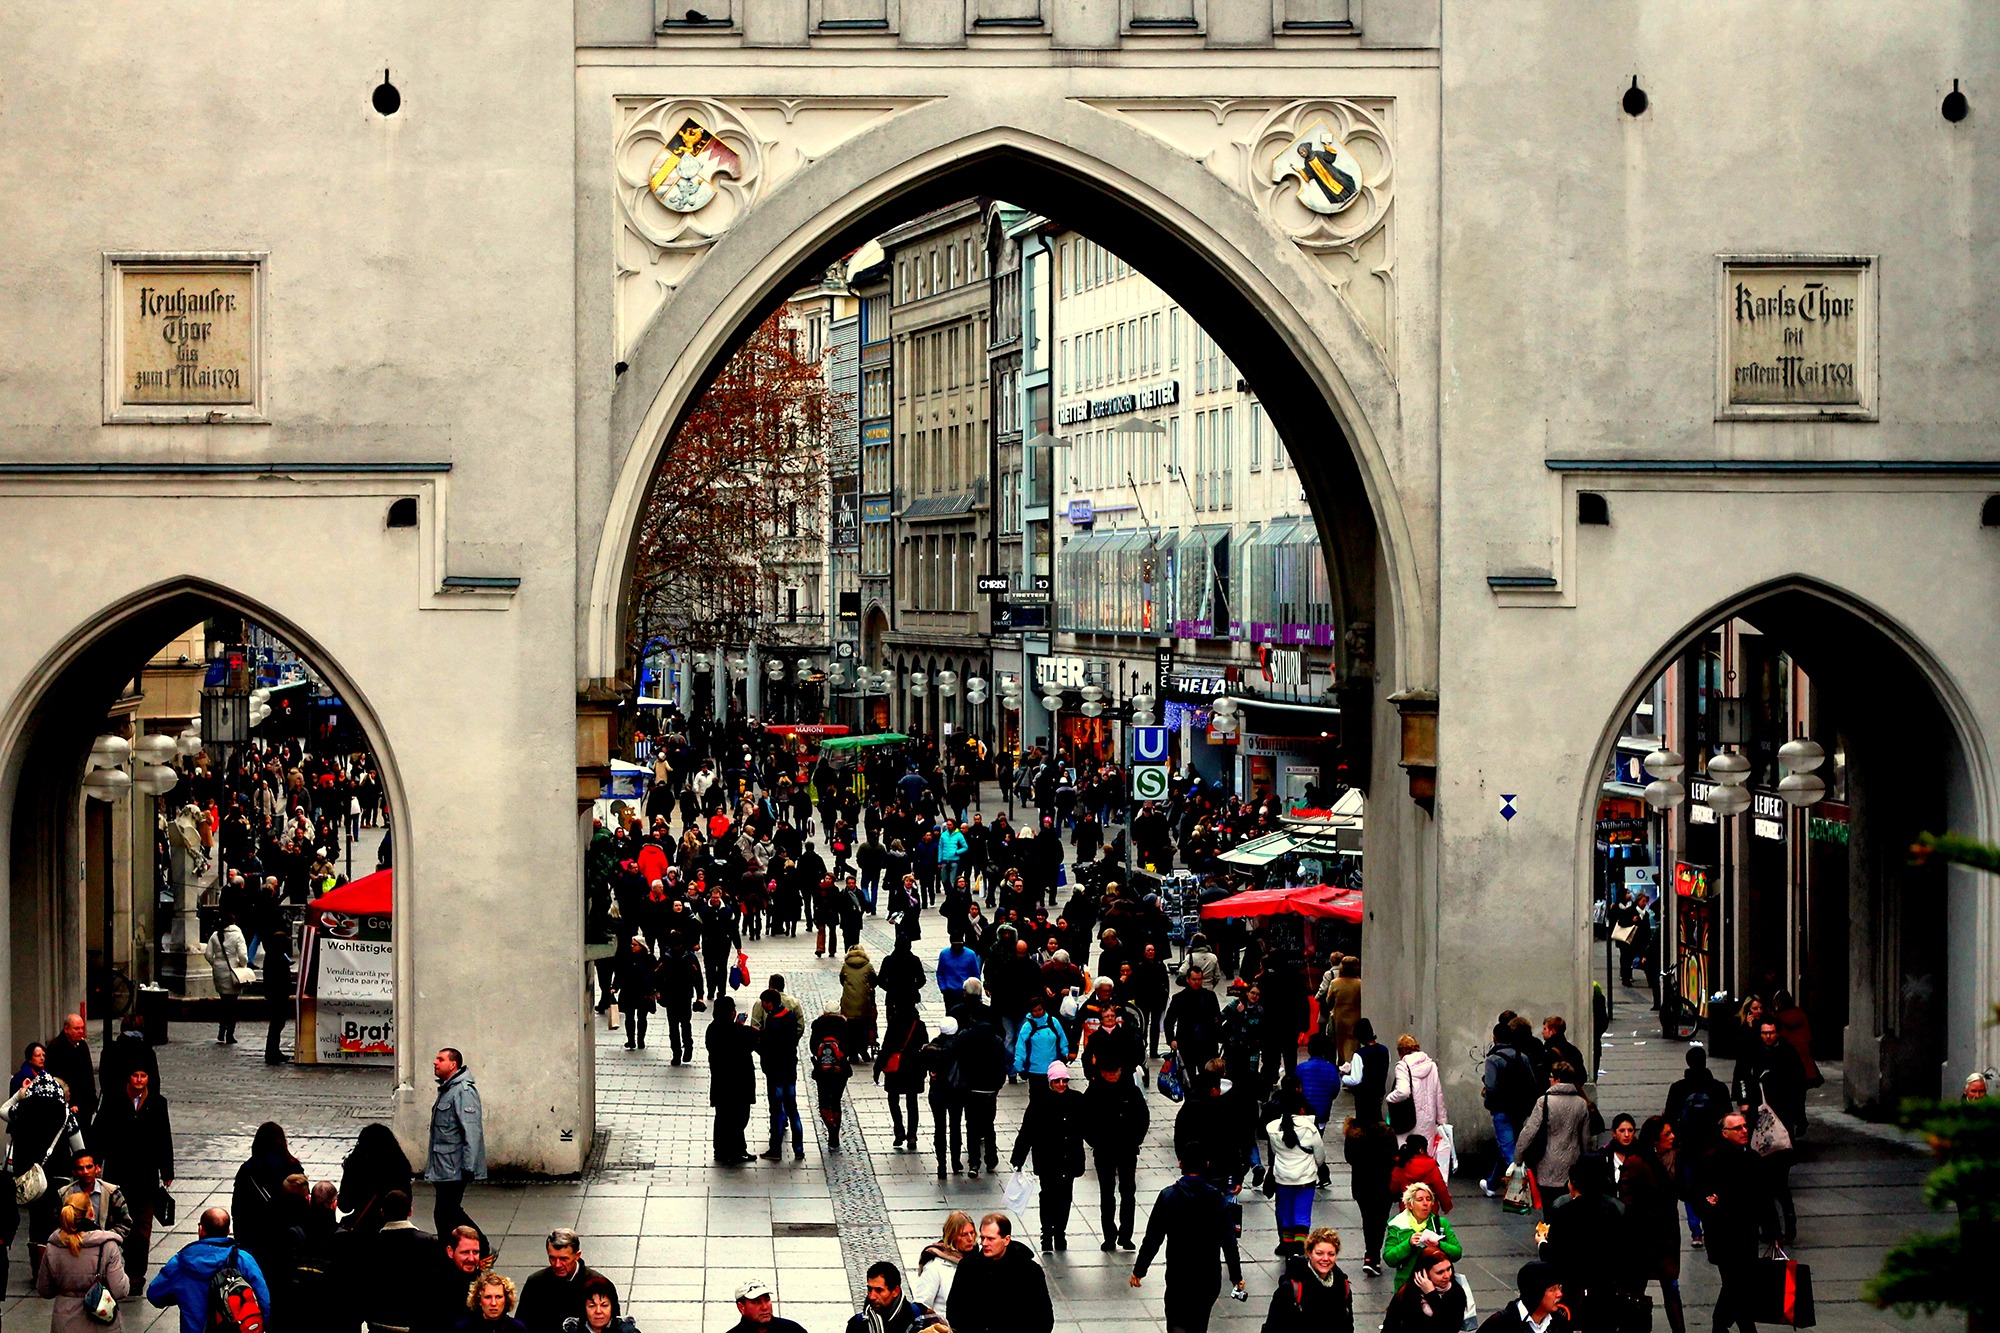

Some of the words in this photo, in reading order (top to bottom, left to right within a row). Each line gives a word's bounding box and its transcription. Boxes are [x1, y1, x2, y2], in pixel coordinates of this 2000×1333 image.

[1798, 283, 1854, 324] Thor
[163, 315, 212, 345] Thor
[176, 345, 198, 362] bis
[135, 370, 162, 390] zum
[175, 364, 210, 389] Mai
[1776, 356, 1818, 388] Mai
[979, 580, 1007, 589] CHRIST
[1272, 650, 1301, 685] SATURN
[1179, 678, 1226, 694] HELA
[1139, 730, 1163, 758] U
[1140, 769, 1162, 796] S
[326, 967, 354, 976] Vendita
[335, 976, 359, 984] Venda
